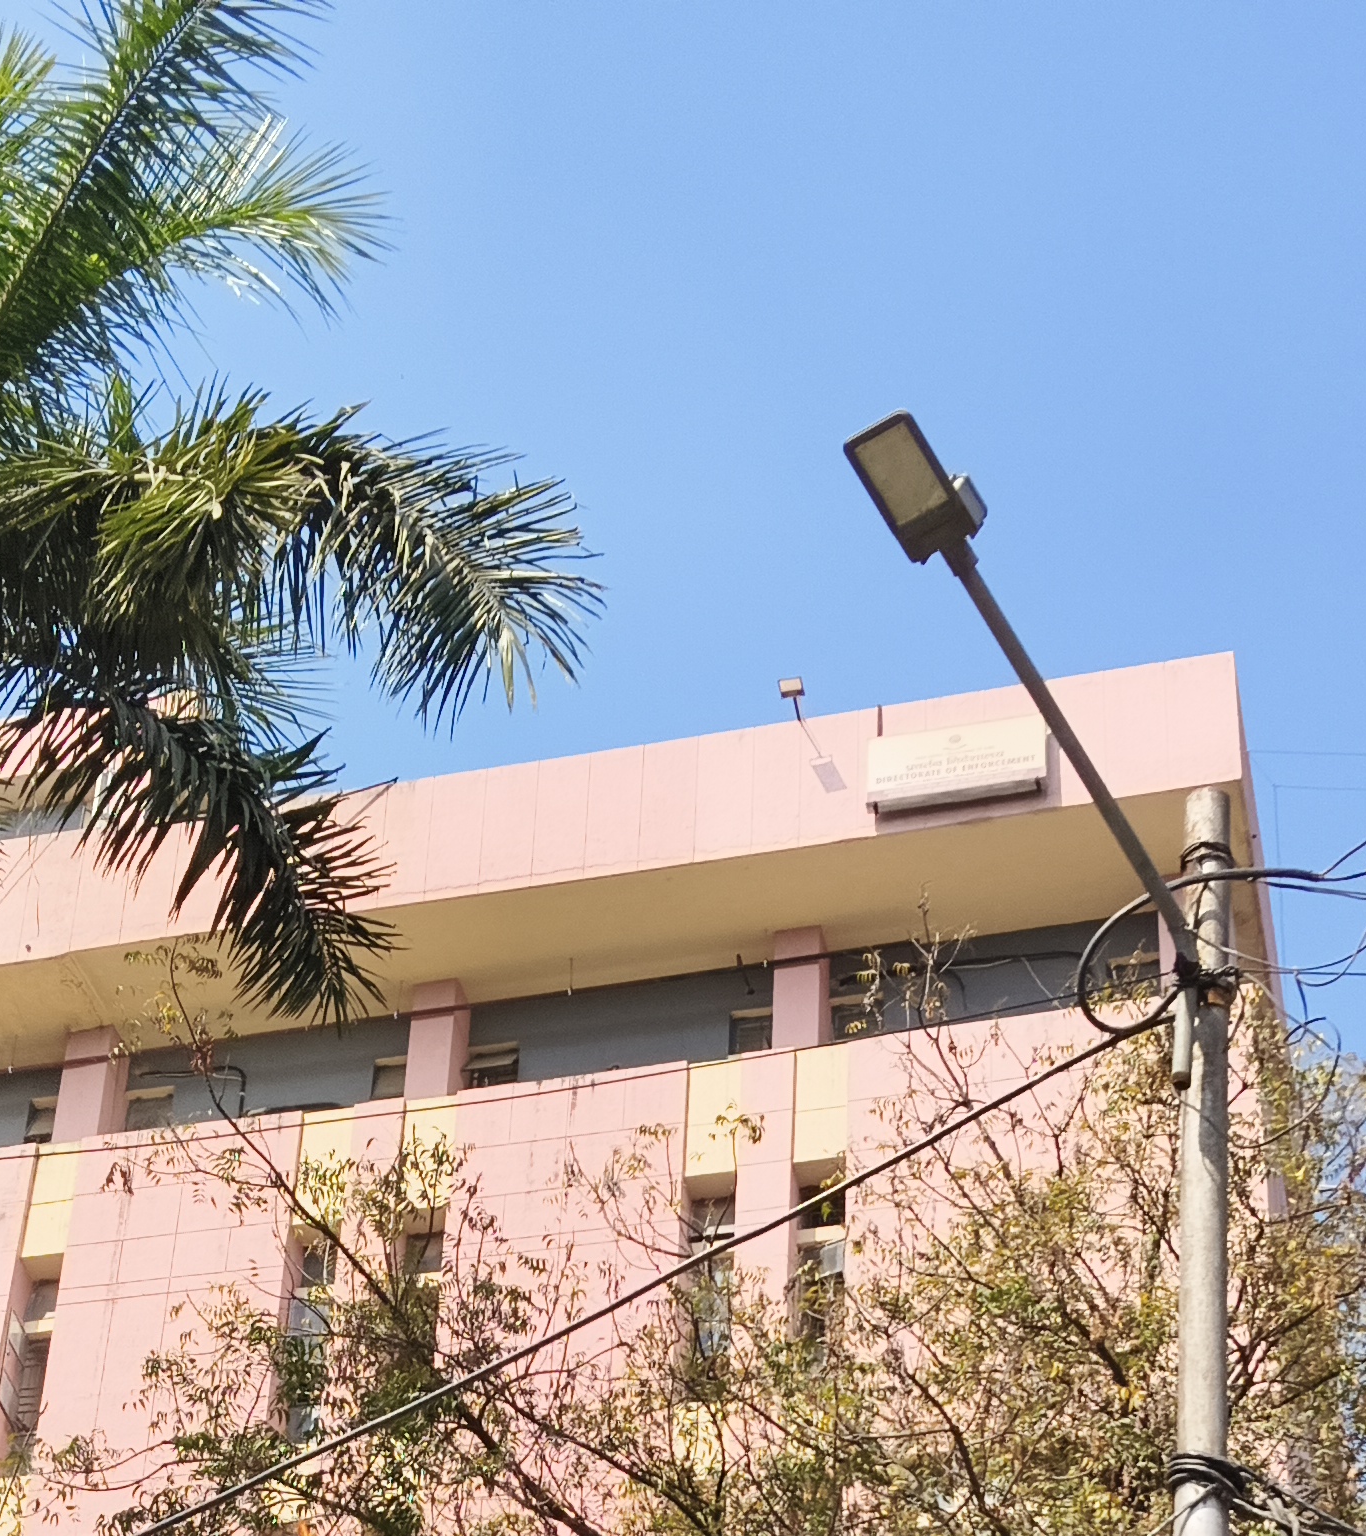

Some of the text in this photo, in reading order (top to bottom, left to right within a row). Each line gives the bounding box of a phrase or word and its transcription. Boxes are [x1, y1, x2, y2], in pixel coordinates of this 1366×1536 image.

[876, 768, 941, 784] DIRECTORATE
[946, 765, 957, 774] OF
[962, 754, 1036, 772] ENFORCEMENT
